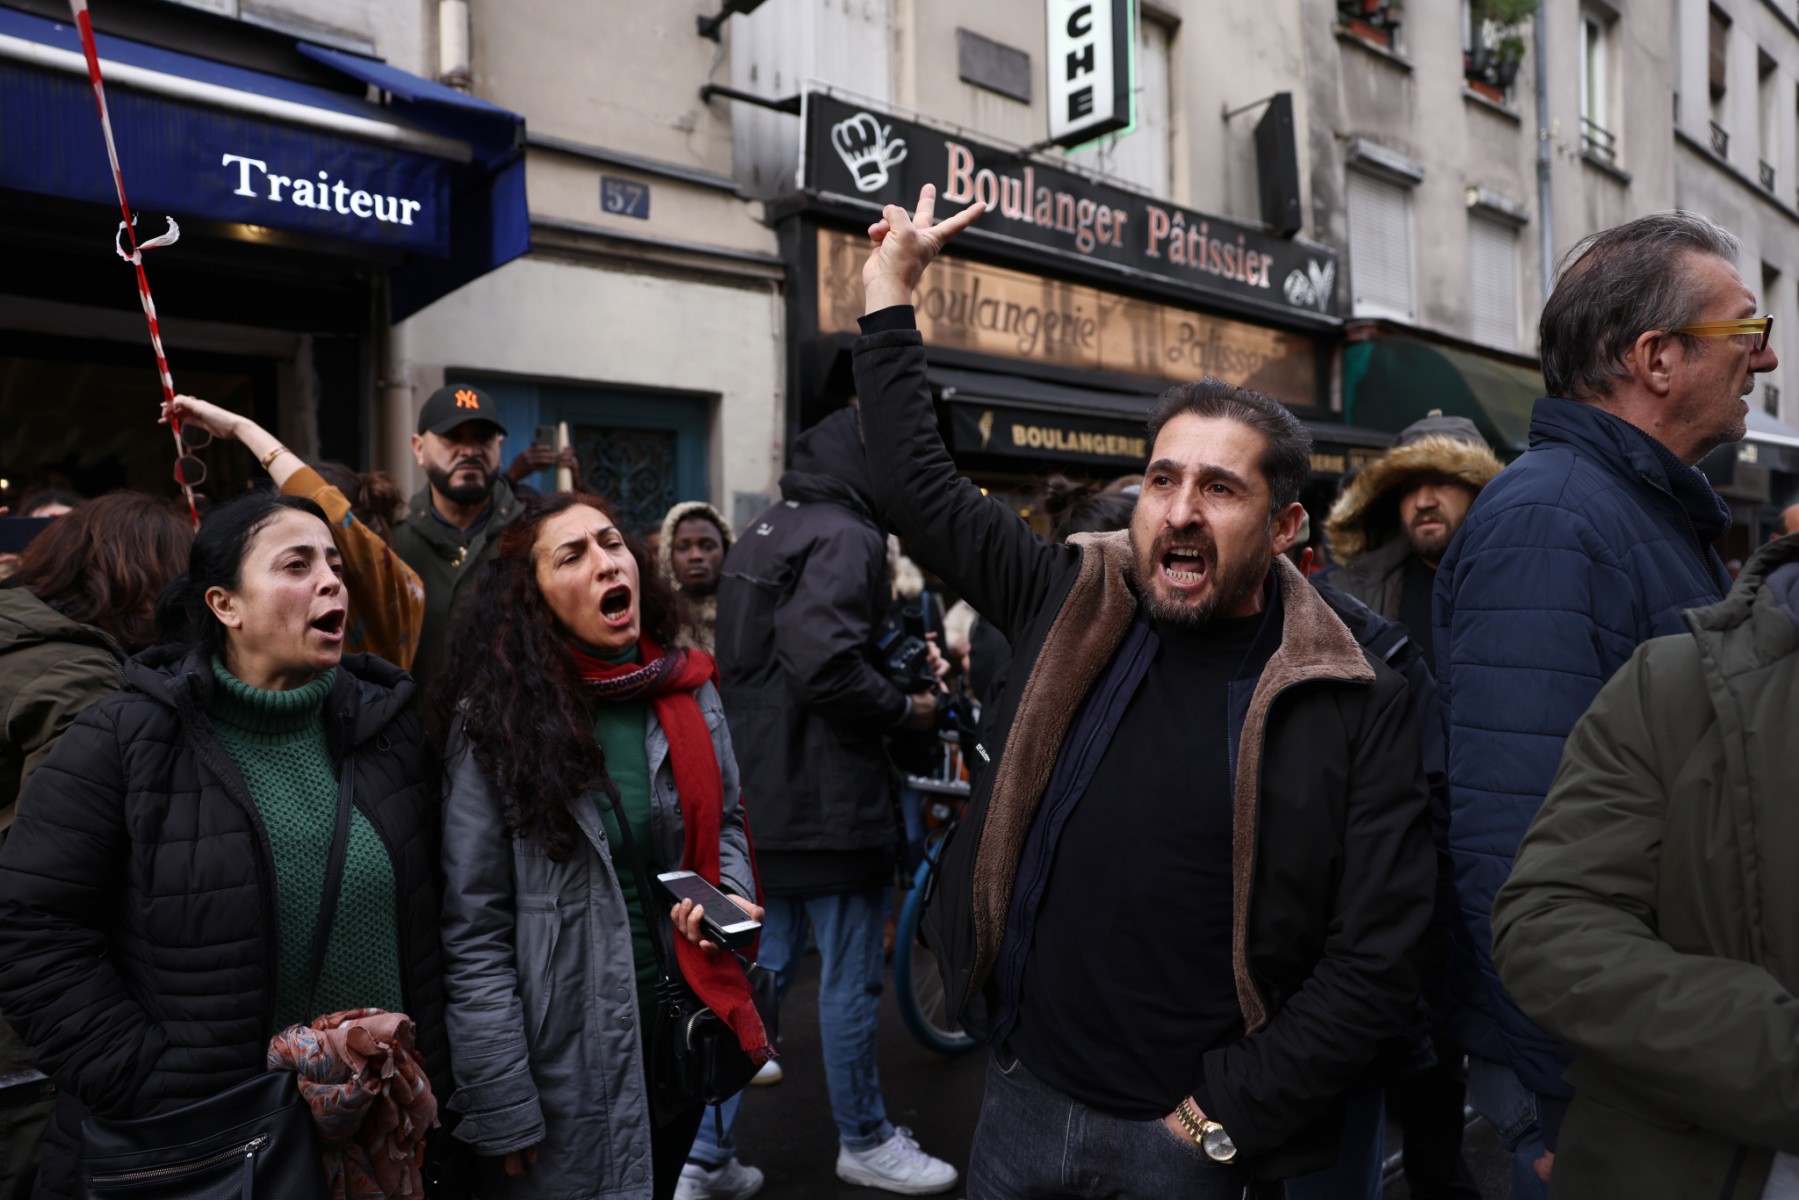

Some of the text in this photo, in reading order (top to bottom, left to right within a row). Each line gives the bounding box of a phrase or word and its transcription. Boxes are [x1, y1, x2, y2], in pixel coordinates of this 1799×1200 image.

[222, 153, 421, 226] Traiteur
[606, 180, 643, 214] 57
[942, 141, 1274, 289] Boulanger Pâtissier
[454, 389, 480, 409] NY
[1011, 423, 1146, 459] BOULANGERIE
